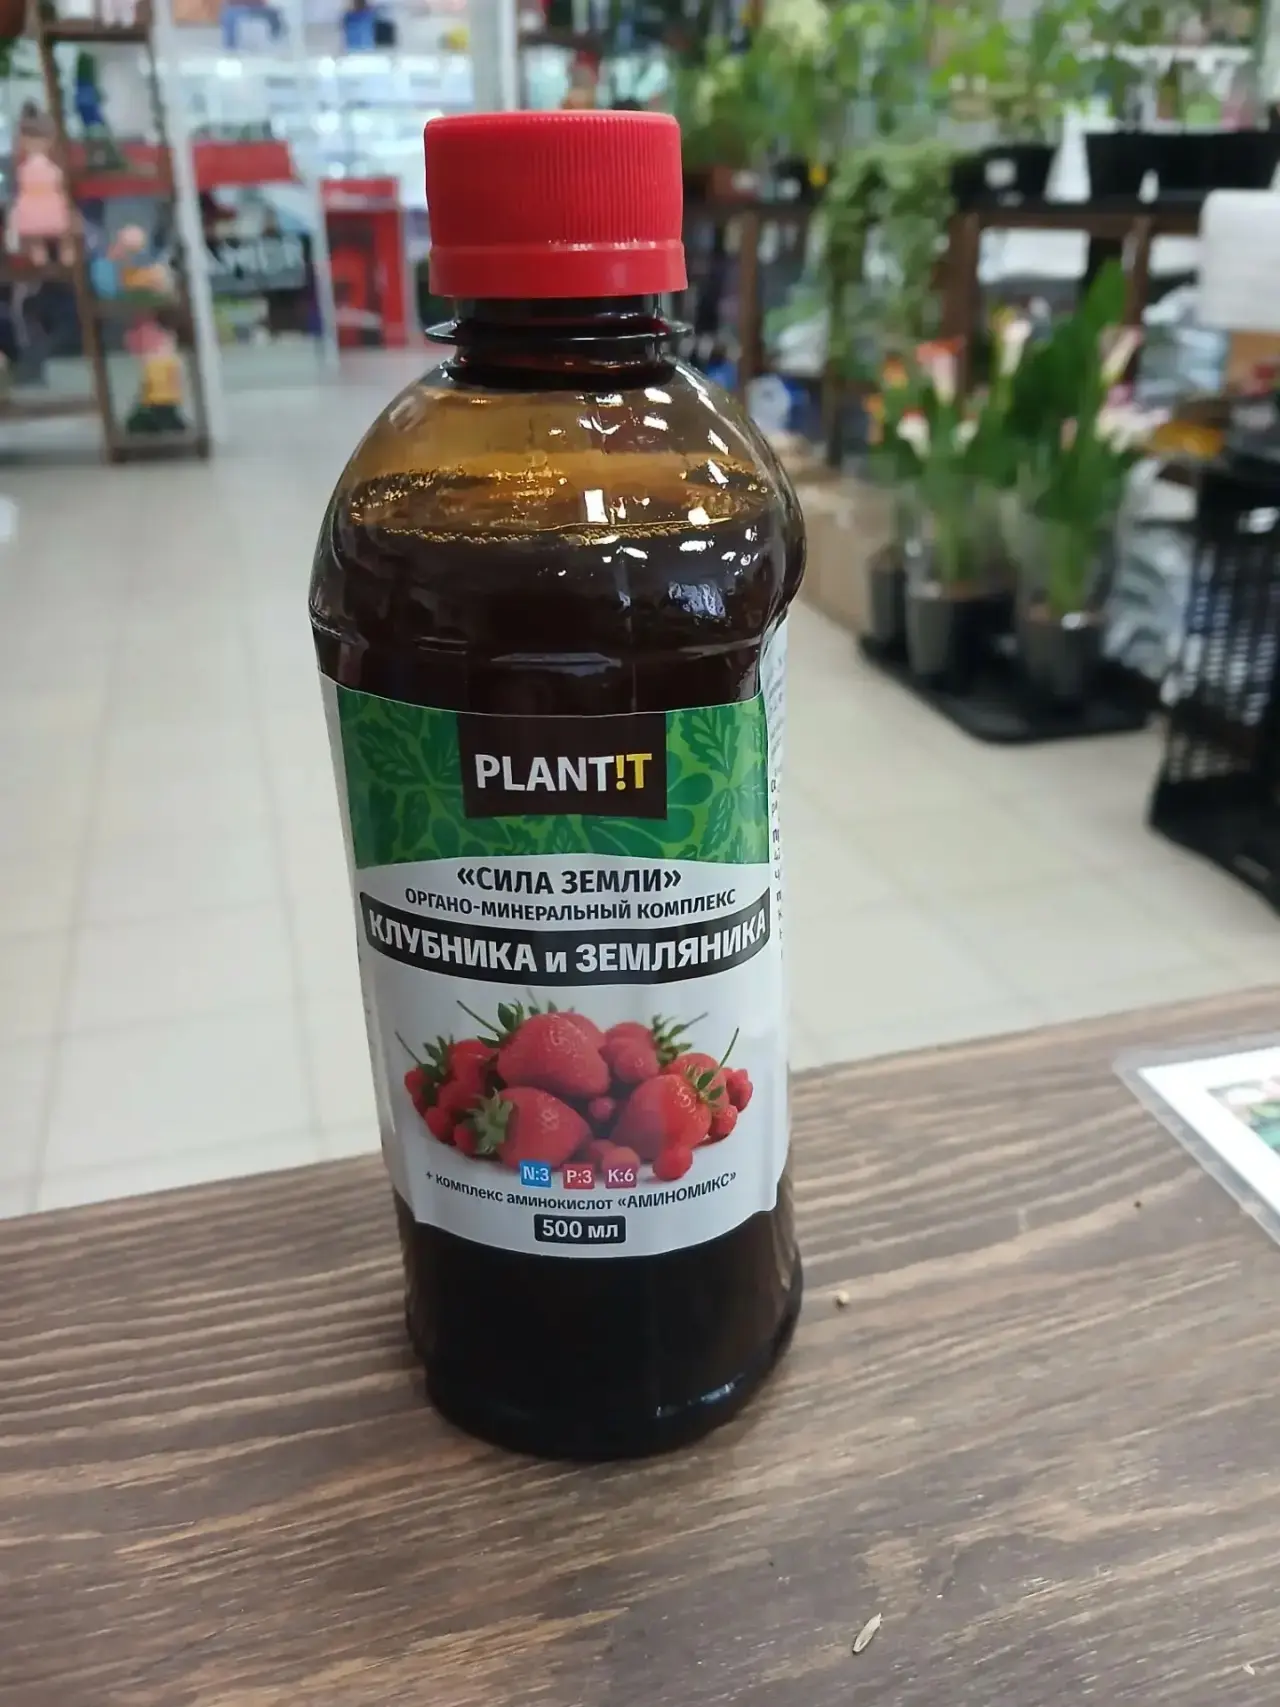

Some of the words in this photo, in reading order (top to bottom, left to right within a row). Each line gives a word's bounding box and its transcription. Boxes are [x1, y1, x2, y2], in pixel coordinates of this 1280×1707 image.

[474, 752, 653, 791] PLANT!T
[457, 866, 554, 895] «СИЛА
[560, 868, 682, 895] ЗЕМЛИ»
[404, 887, 632, 921] ОРГАНО-МИНЕРАЛЬНЫЙ
[636, 888, 737, 920] КОМПЛЕКС
[368, 909, 538, 972] КЛУБНИКА
[545, 951, 567, 973] и
[575, 909, 767, 973] ЗЕМЛЯНИКА
[435, 1172, 504, 1203] комплекс
[506, 1192, 613, 1211] аминокислот
[617, 1171, 738, 1209] «АМИНОМИКС»
[522, 1165, 550, 1183] N:3
[566, 1168, 593, 1185] P:3
[607, 1167, 635, 1184] K:6
[541, 1219, 583, 1239] 500
[588, 1224, 619, 1239] мл
